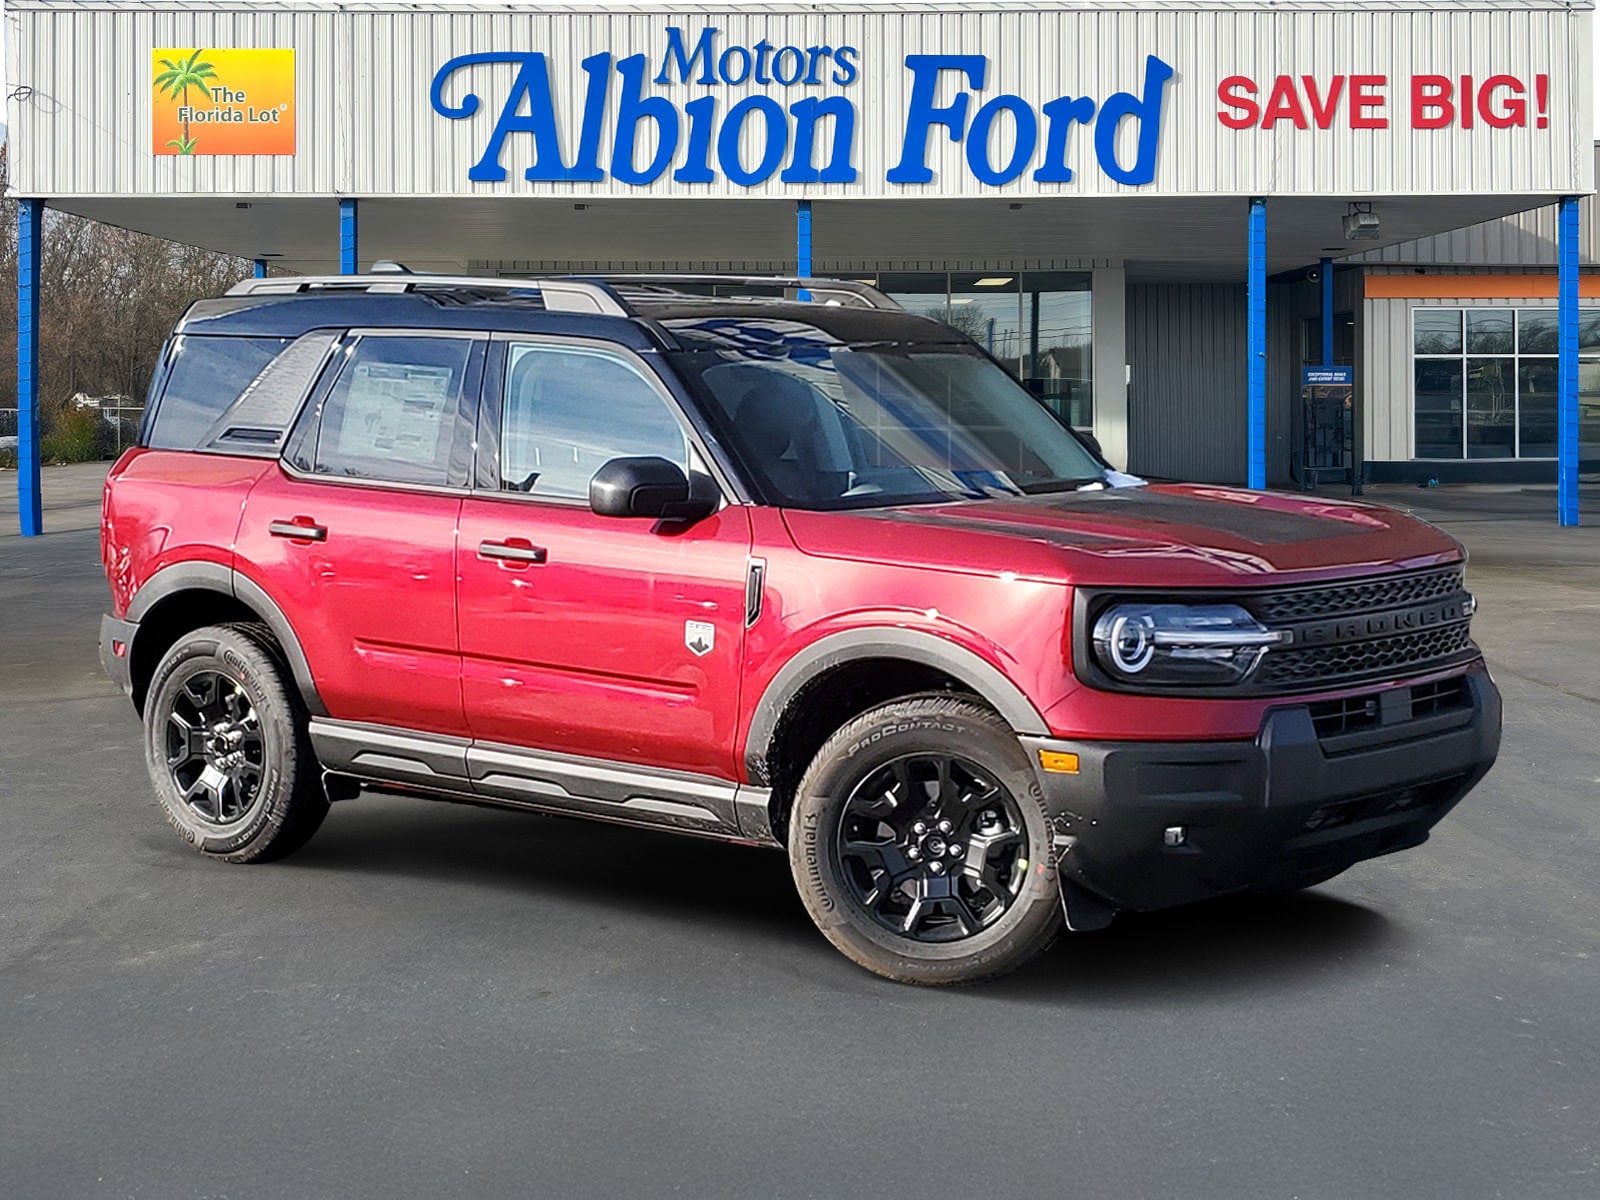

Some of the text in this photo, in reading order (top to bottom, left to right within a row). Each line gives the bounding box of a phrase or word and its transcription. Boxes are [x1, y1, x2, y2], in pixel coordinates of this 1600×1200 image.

[653, 26, 859, 87] Motors
[178, 106, 279, 123] Florida Lot
[210, 86, 246, 103] The
[430, 51, 1174, 187] Albion Ford
[1217, 74, 1549, 130] SAVE BIG!
[804, 825, 834, 912] Continental
